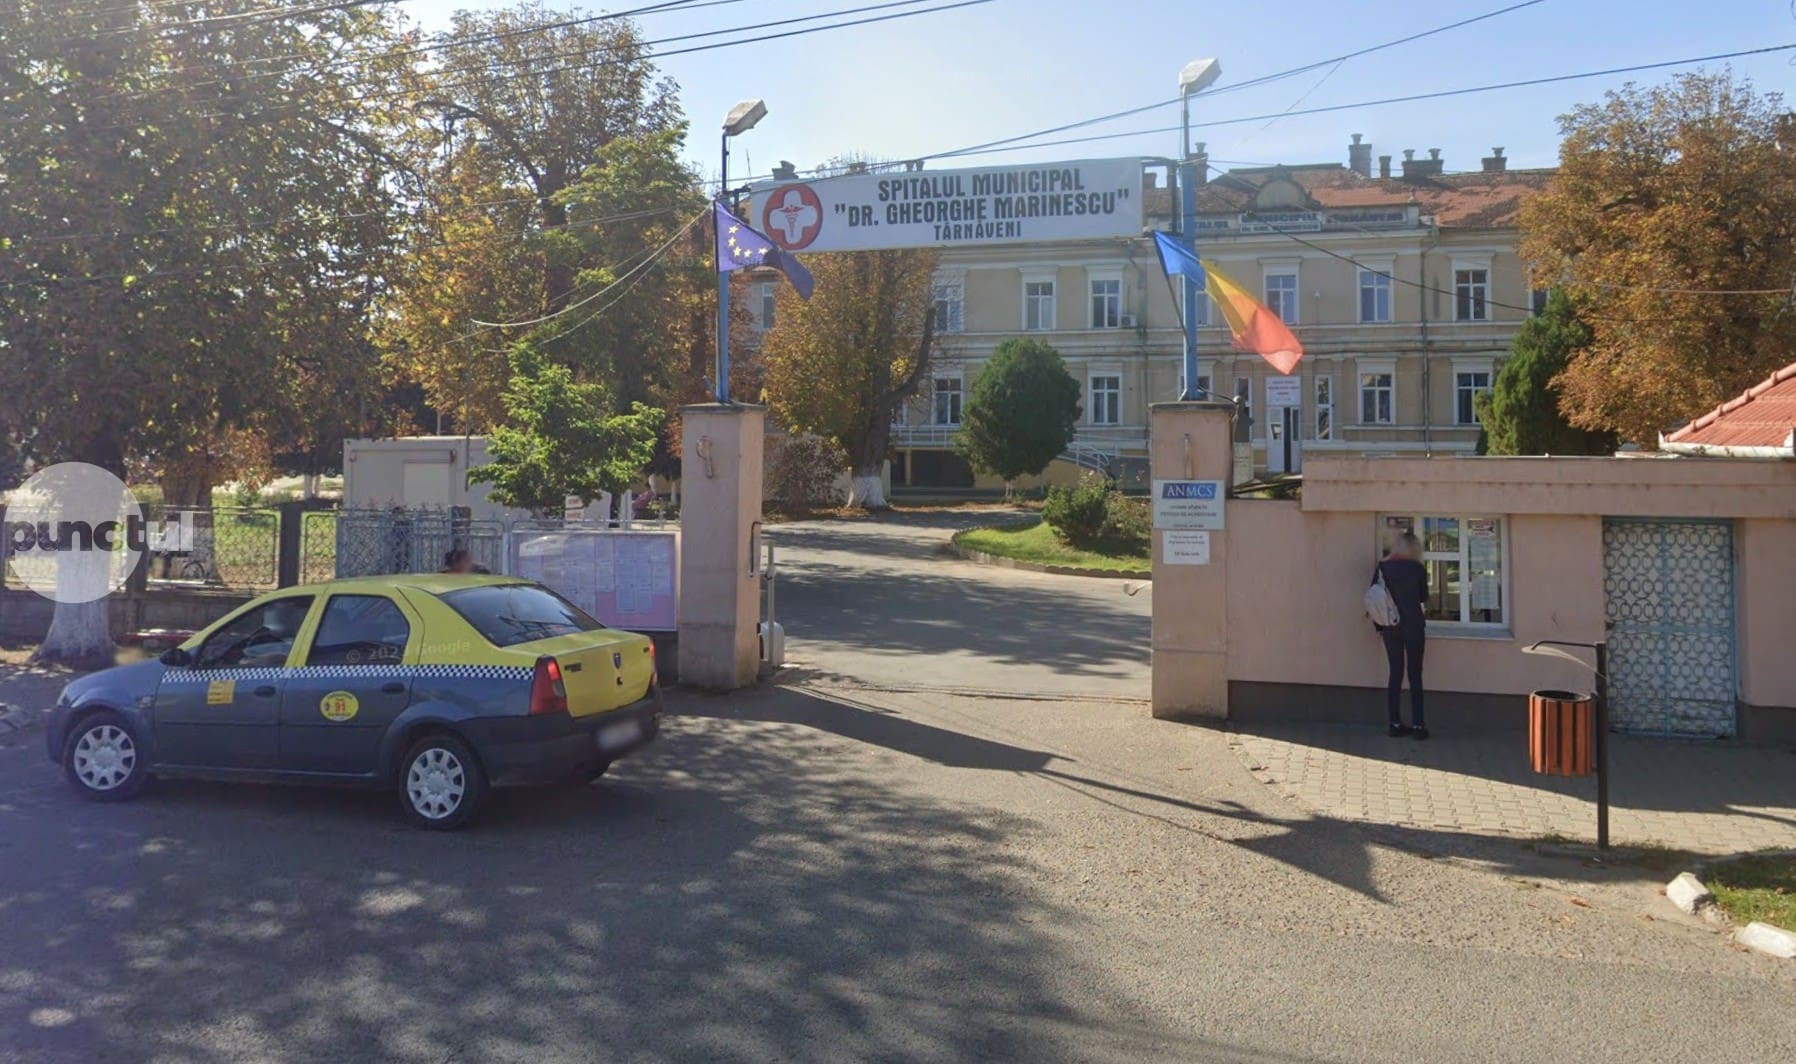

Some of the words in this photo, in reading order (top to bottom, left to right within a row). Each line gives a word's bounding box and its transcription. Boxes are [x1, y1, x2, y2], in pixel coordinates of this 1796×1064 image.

[878, 174, 966, 202] SPITALUL
[972, 168, 1085, 197] MUNICIPAL
[886, 197, 987, 226] GHEORGHE
[994, 188, 1130, 219] MARINESCU"
[1167, 484, 1214, 498] ANMCS
